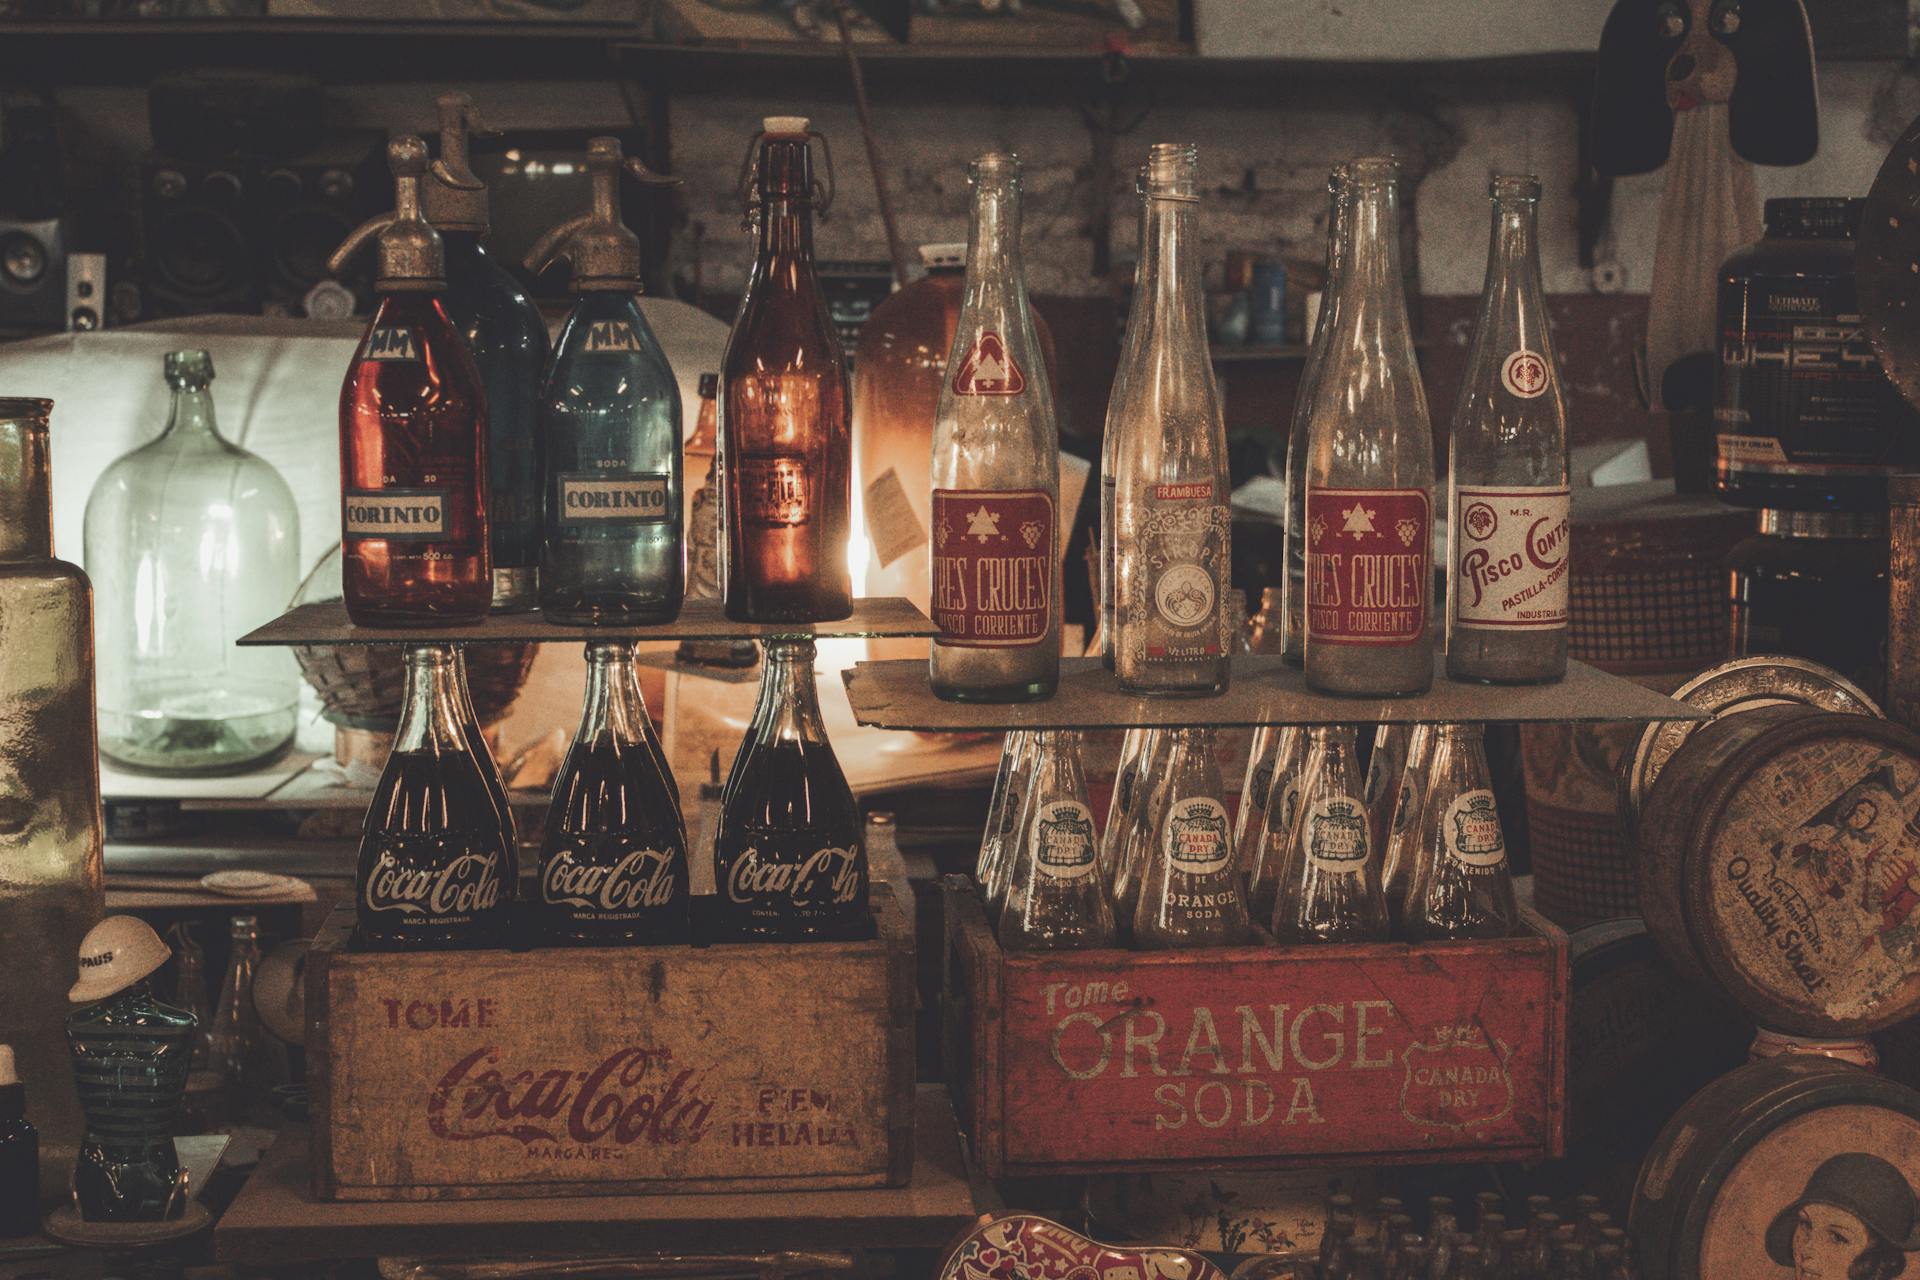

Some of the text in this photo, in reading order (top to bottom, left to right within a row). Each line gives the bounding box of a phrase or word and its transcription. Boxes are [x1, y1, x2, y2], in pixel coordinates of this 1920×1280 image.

[1769, 295, 1819, 305] ULTIMATE
[591, 322, 635, 350] MM
[1724, 345, 1876, 368] WHEY
[597, 459, 626, 467] SODA
[566, 490, 665, 509] CORINTO
[1157, 485, 1213, 499] FRAMBUESA
[348, 505, 441, 524] CORINTO
[1510, 508, 1533, 517] M.R.
[935, 556, 1046, 612] TRES CRUCES
[1308, 554, 1421, 608] TRES CRUCES
[1313, 610, 1413, 632] PISCO CORRIENTE
[1517, 609, 1557, 619] INDUSTRIA
[939, 613, 1039, 636] PISCO CORRIENTE
[1181, 646, 1206, 656] LITRO
[1046, 835, 1086, 844] CANADA
[1178, 833, 1218, 843] CANADA
[1320, 831, 1360, 840] CANADA
[1477, 834, 1495, 843] DRY
[1189, 844, 1209, 853] DRY
[1330, 842, 1350, 850] DRY
[1166, 890, 1236, 908] ORANGE
[1727, 856, 1781, 938] Quality
[573, 912, 596, 920] MARCA
[1186, 910, 1221, 919] SODA
[383, 998, 499, 1031] TOME
[1051, 1000, 1394, 1080] ORANGE
[1414, 1066, 1501, 1086] CANADA
[1154, 1077, 1326, 1131] SODA
[1439, 1090, 1481, 1108] DRY
